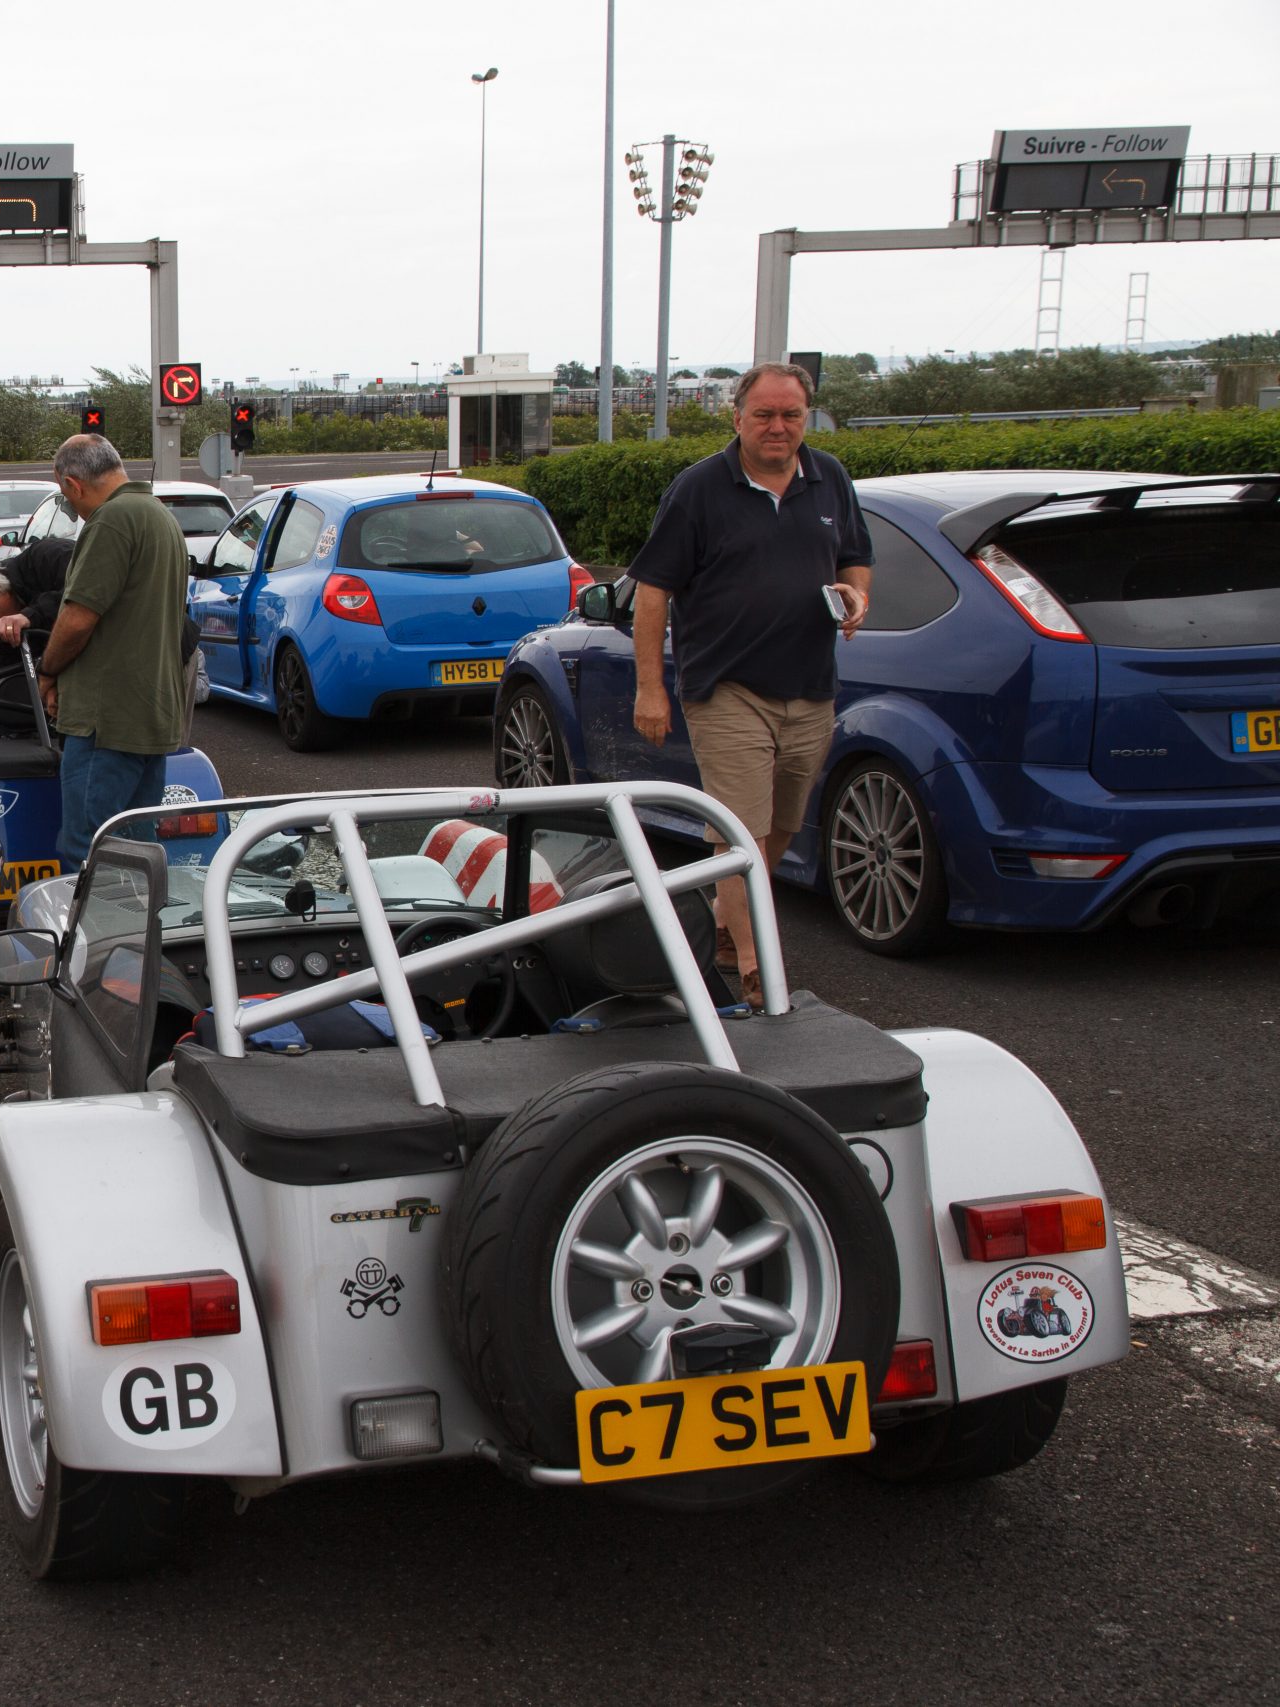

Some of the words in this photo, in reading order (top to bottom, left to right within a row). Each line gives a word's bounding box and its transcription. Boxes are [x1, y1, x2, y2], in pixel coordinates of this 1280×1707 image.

[1023, 136, 1086, 155] Suivre
[1102, 134, 1169, 153] Follow
[444, 662, 488, 681] HY58
[492, 661, 506, 678] L
[1109, 749, 1168, 757] FOCUS
[469, 794, 493, 810] 24
[331, 1205, 440, 1223] CATERHAM
[985, 1277, 1013, 1307] Lotus
[1015, 1270, 1054, 1281] Seven
[1057, 1275, 1083, 1301] Club
[985, 1316, 1006, 1347] Sevens
[1018, 1348, 1029, 1356] La
[1031, 1348, 1060, 1357] Sarthe
[1060, 1343, 1069, 1351] in
[1069, 1306, 1088, 1344] Summer
[119, 1362, 218, 1435] GB
[589, 1391, 685, 1467] C7
[711, 1373, 857, 1452] SEV
